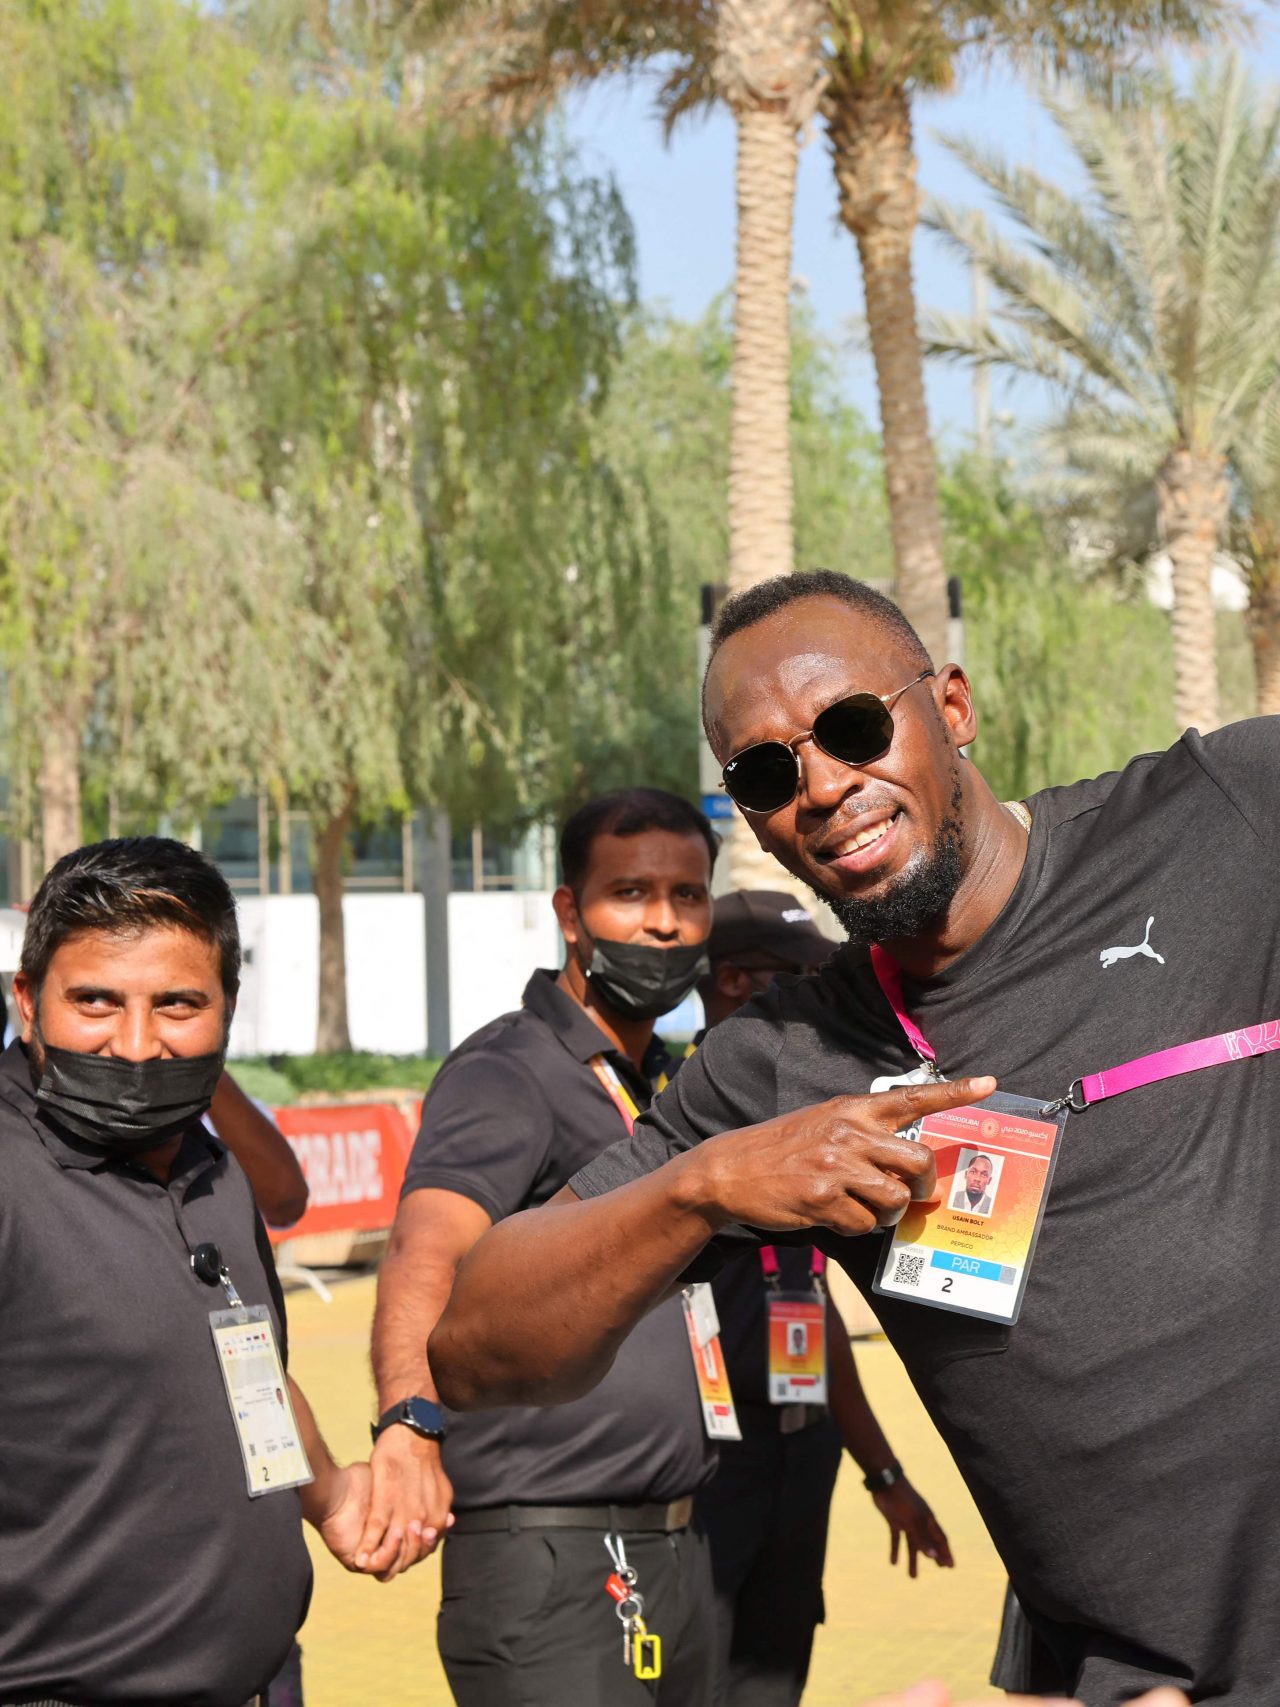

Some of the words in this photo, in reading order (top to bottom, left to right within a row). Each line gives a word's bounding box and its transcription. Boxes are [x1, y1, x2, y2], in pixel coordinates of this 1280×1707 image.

[952, 1215, 970, 1225] USAIN
[970, 1218, 984, 1226] BOLT
[937, 1224, 956, 1233] BRAND
[956, 1228, 994, 1241] AMBASSADOR
[950, 1240, 974, 1250] PEPSICO
[951, 1257, 981, 1274] PAR
[941, 1277, 954, 1293] 2
[262, 1466, 270, 1482] 2
